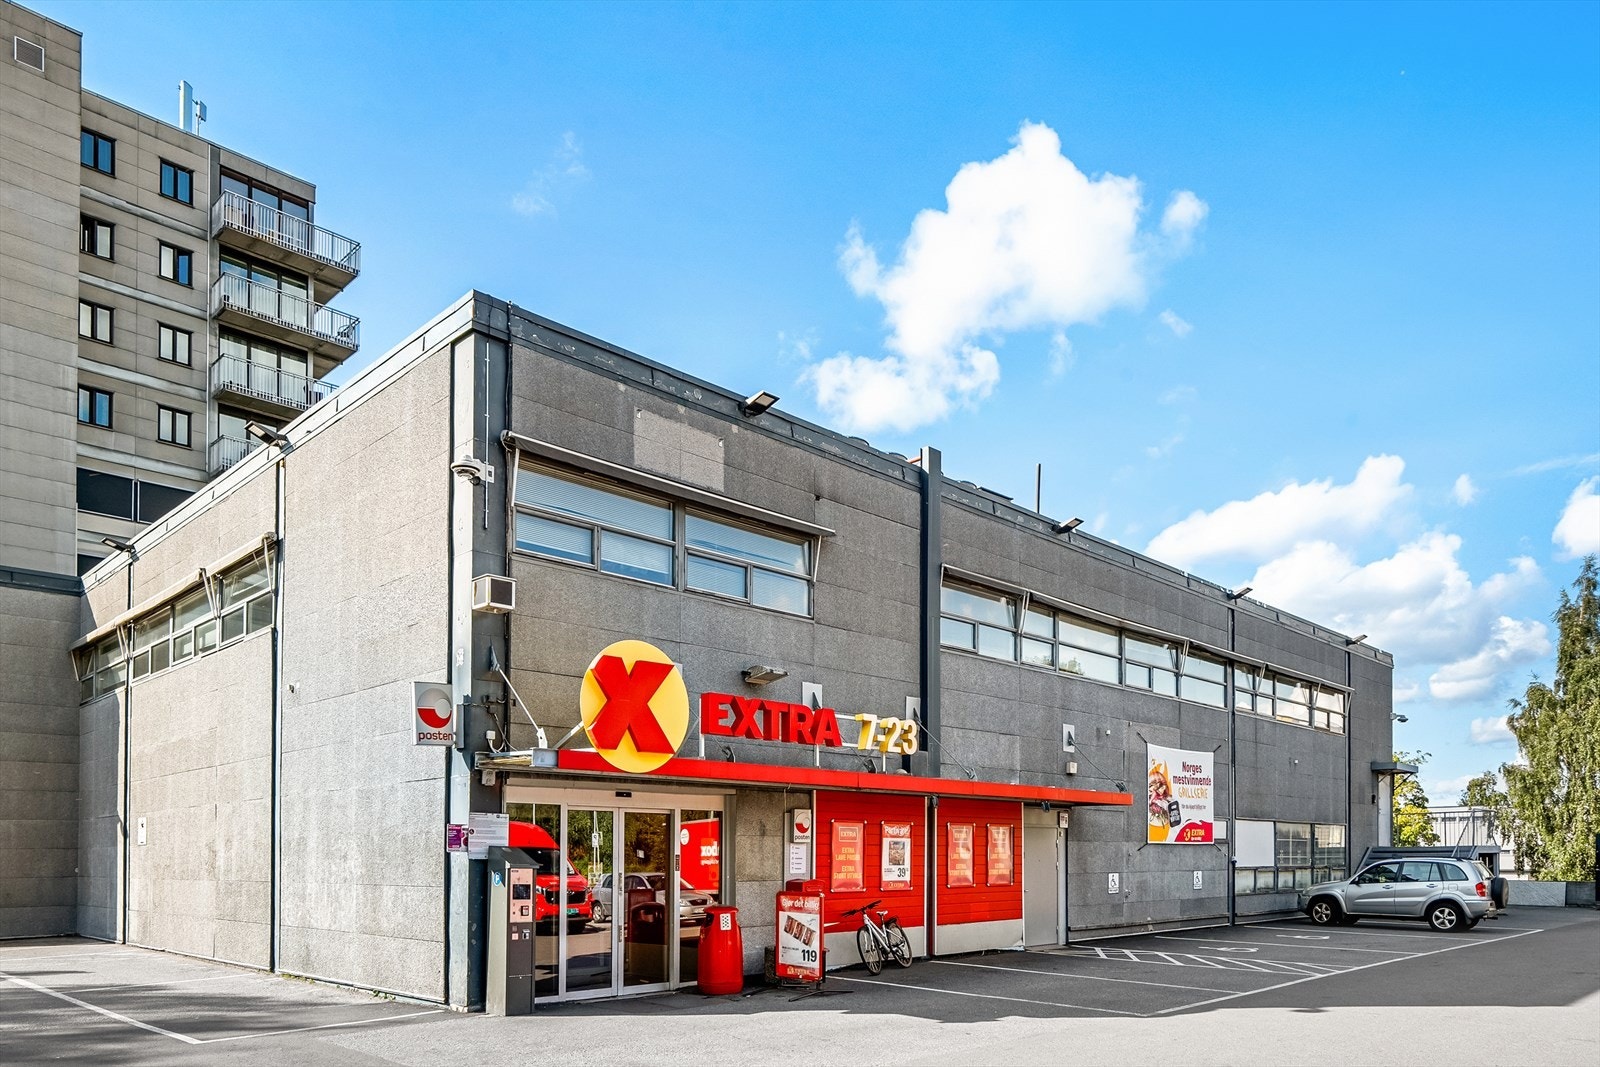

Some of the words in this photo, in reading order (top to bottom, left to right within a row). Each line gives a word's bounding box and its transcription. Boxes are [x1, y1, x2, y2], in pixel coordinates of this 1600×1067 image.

[701, 692, 842, 747] EXTRA
[855, 713, 918, 755] 7-23
[418, 731, 453, 742] posten
[1182, 761, 1203, 775] Norges
[1173, 774, 1211, 786] mestvinnende
[897, 867, 906, 878] 39
[794, 897, 804, 908] det
[801, 949, 818, 963] 119
